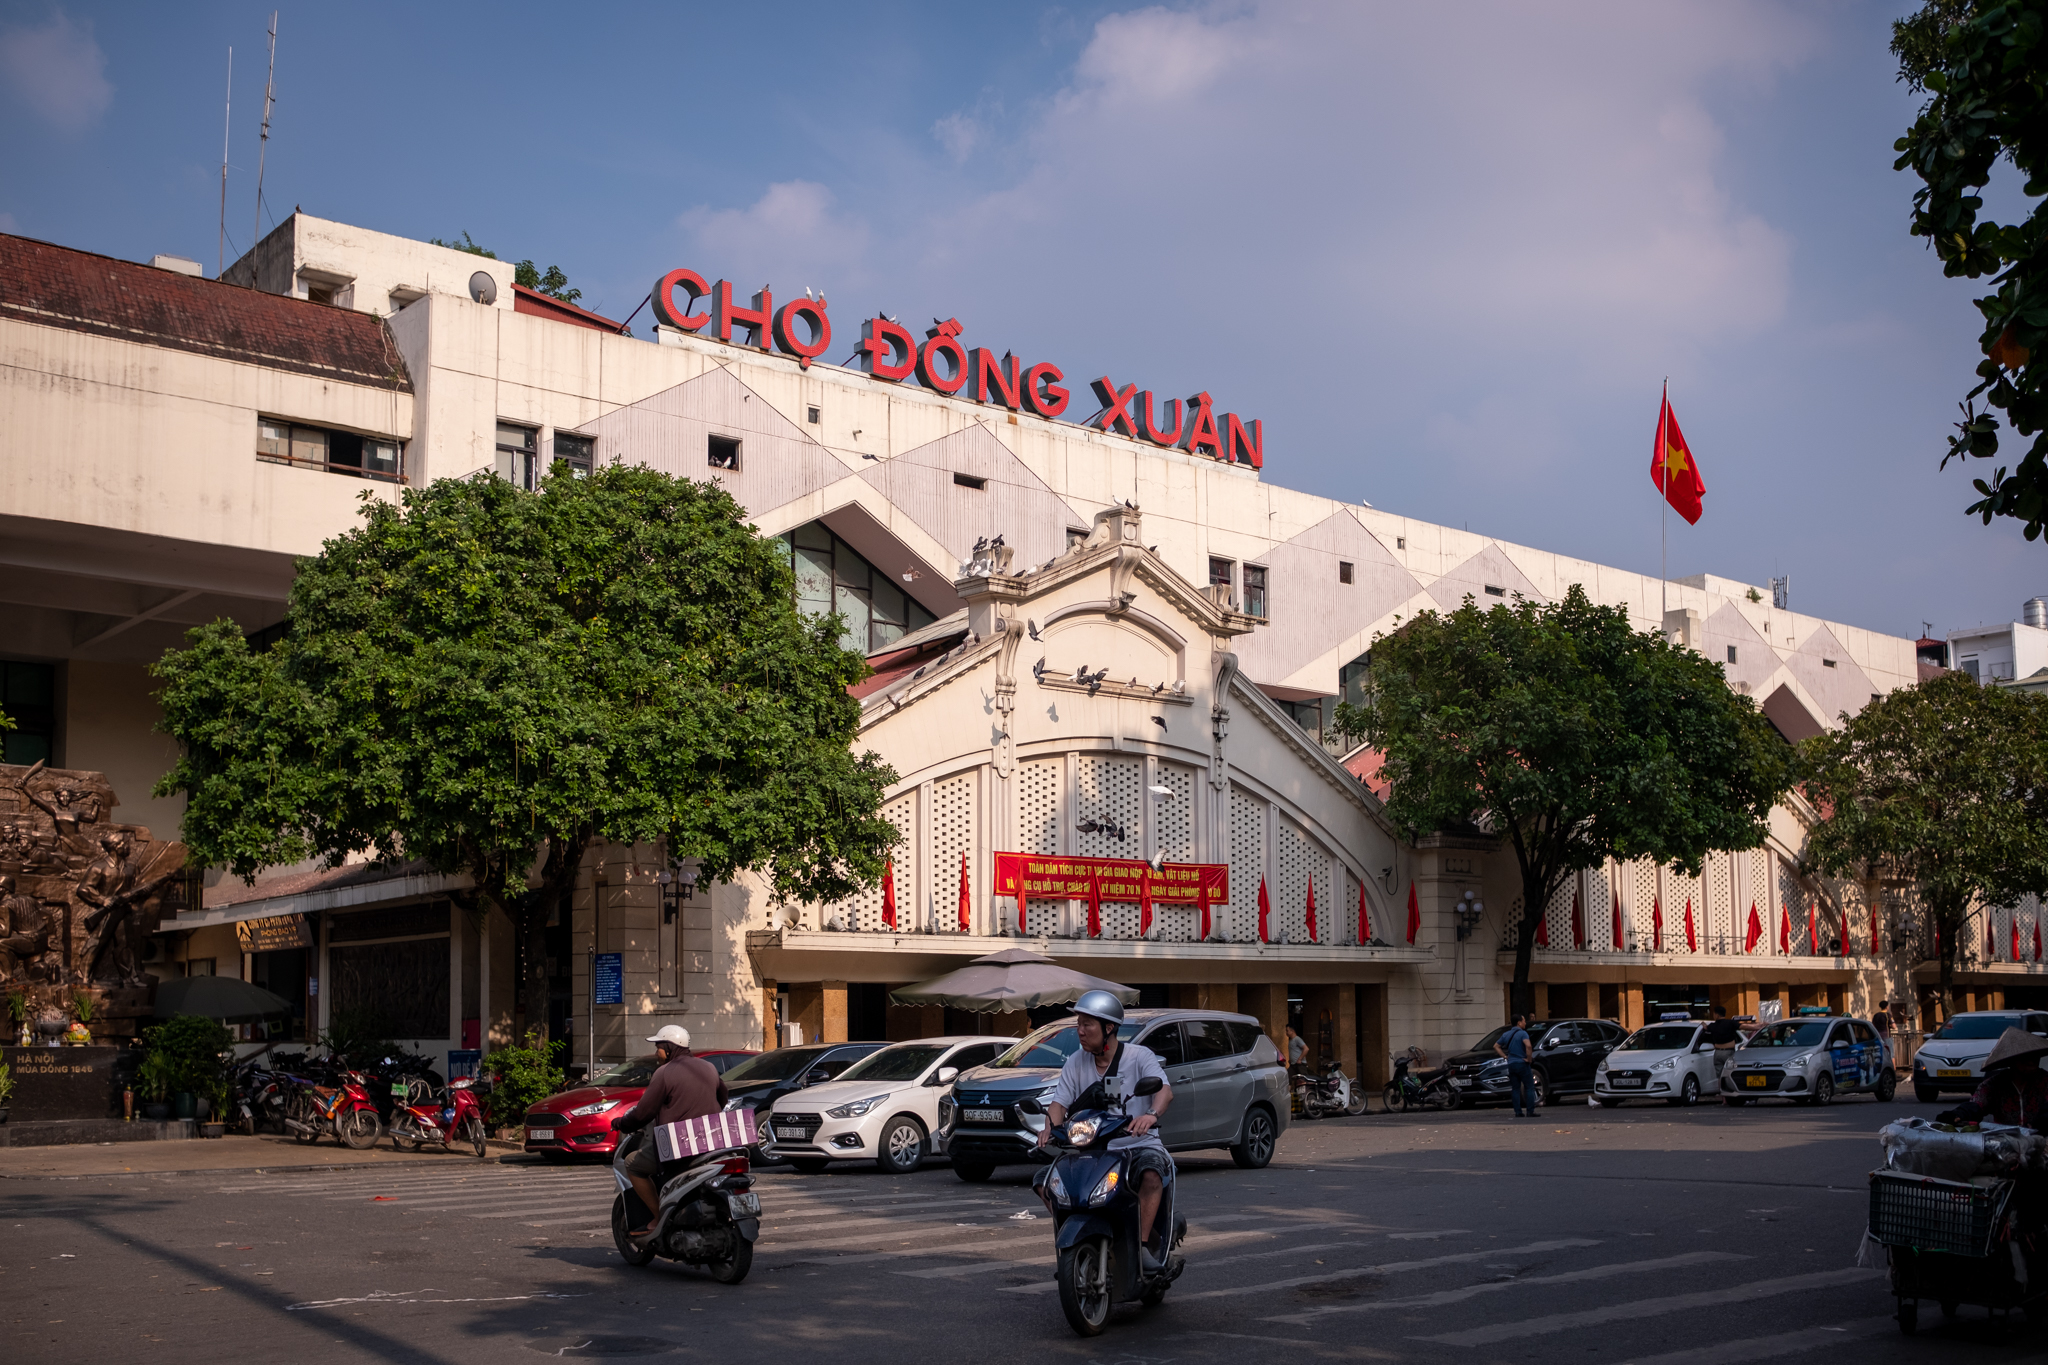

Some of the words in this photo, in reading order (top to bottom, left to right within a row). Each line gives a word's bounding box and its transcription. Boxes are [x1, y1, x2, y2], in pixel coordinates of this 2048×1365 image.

[651, 268, 831, 370] CHỢ
[854, 316, 1070, 418] ĐỒNG
[1090, 375, 1263, 468] XUÂN
[1028, 860, 1044, 874] TOÀN
[1045, 861, 1058, 875] DÂN
[1059, 862, 1074, 876] TÍCH
[1074, 865, 1086, 878] CỰC
[1103, 866, 1113, 877] GIA
[1114, 867, 1128, 878] GIAO
[1130, 866, 1143, 880] NỘP
[1165, 868, 1176, 882] VẬT
[1177, 869, 1190, 883] LIỆU
[1006, 876, 1015, 889] VÀ
[1033, 881, 1041, 893] CỤ
[1067, 880, 1083, 892] CHÀO
[1110, 882, 1126, 896] NIỆM
[1126, 884, 1134, 894] 70
[1151, 884, 1167, 896] NGÀY
[1168, 883, 1180, 897] GIẢI
[17, 1053, 32, 1064] HÀ
[34, 1052, 55, 1065] NỘI
[16, 1064, 38, 1074] MÙA
[40, 1064, 69, 1074] ĐÔNG
[964, 1110, 1003, 1121] 30F-935.42
